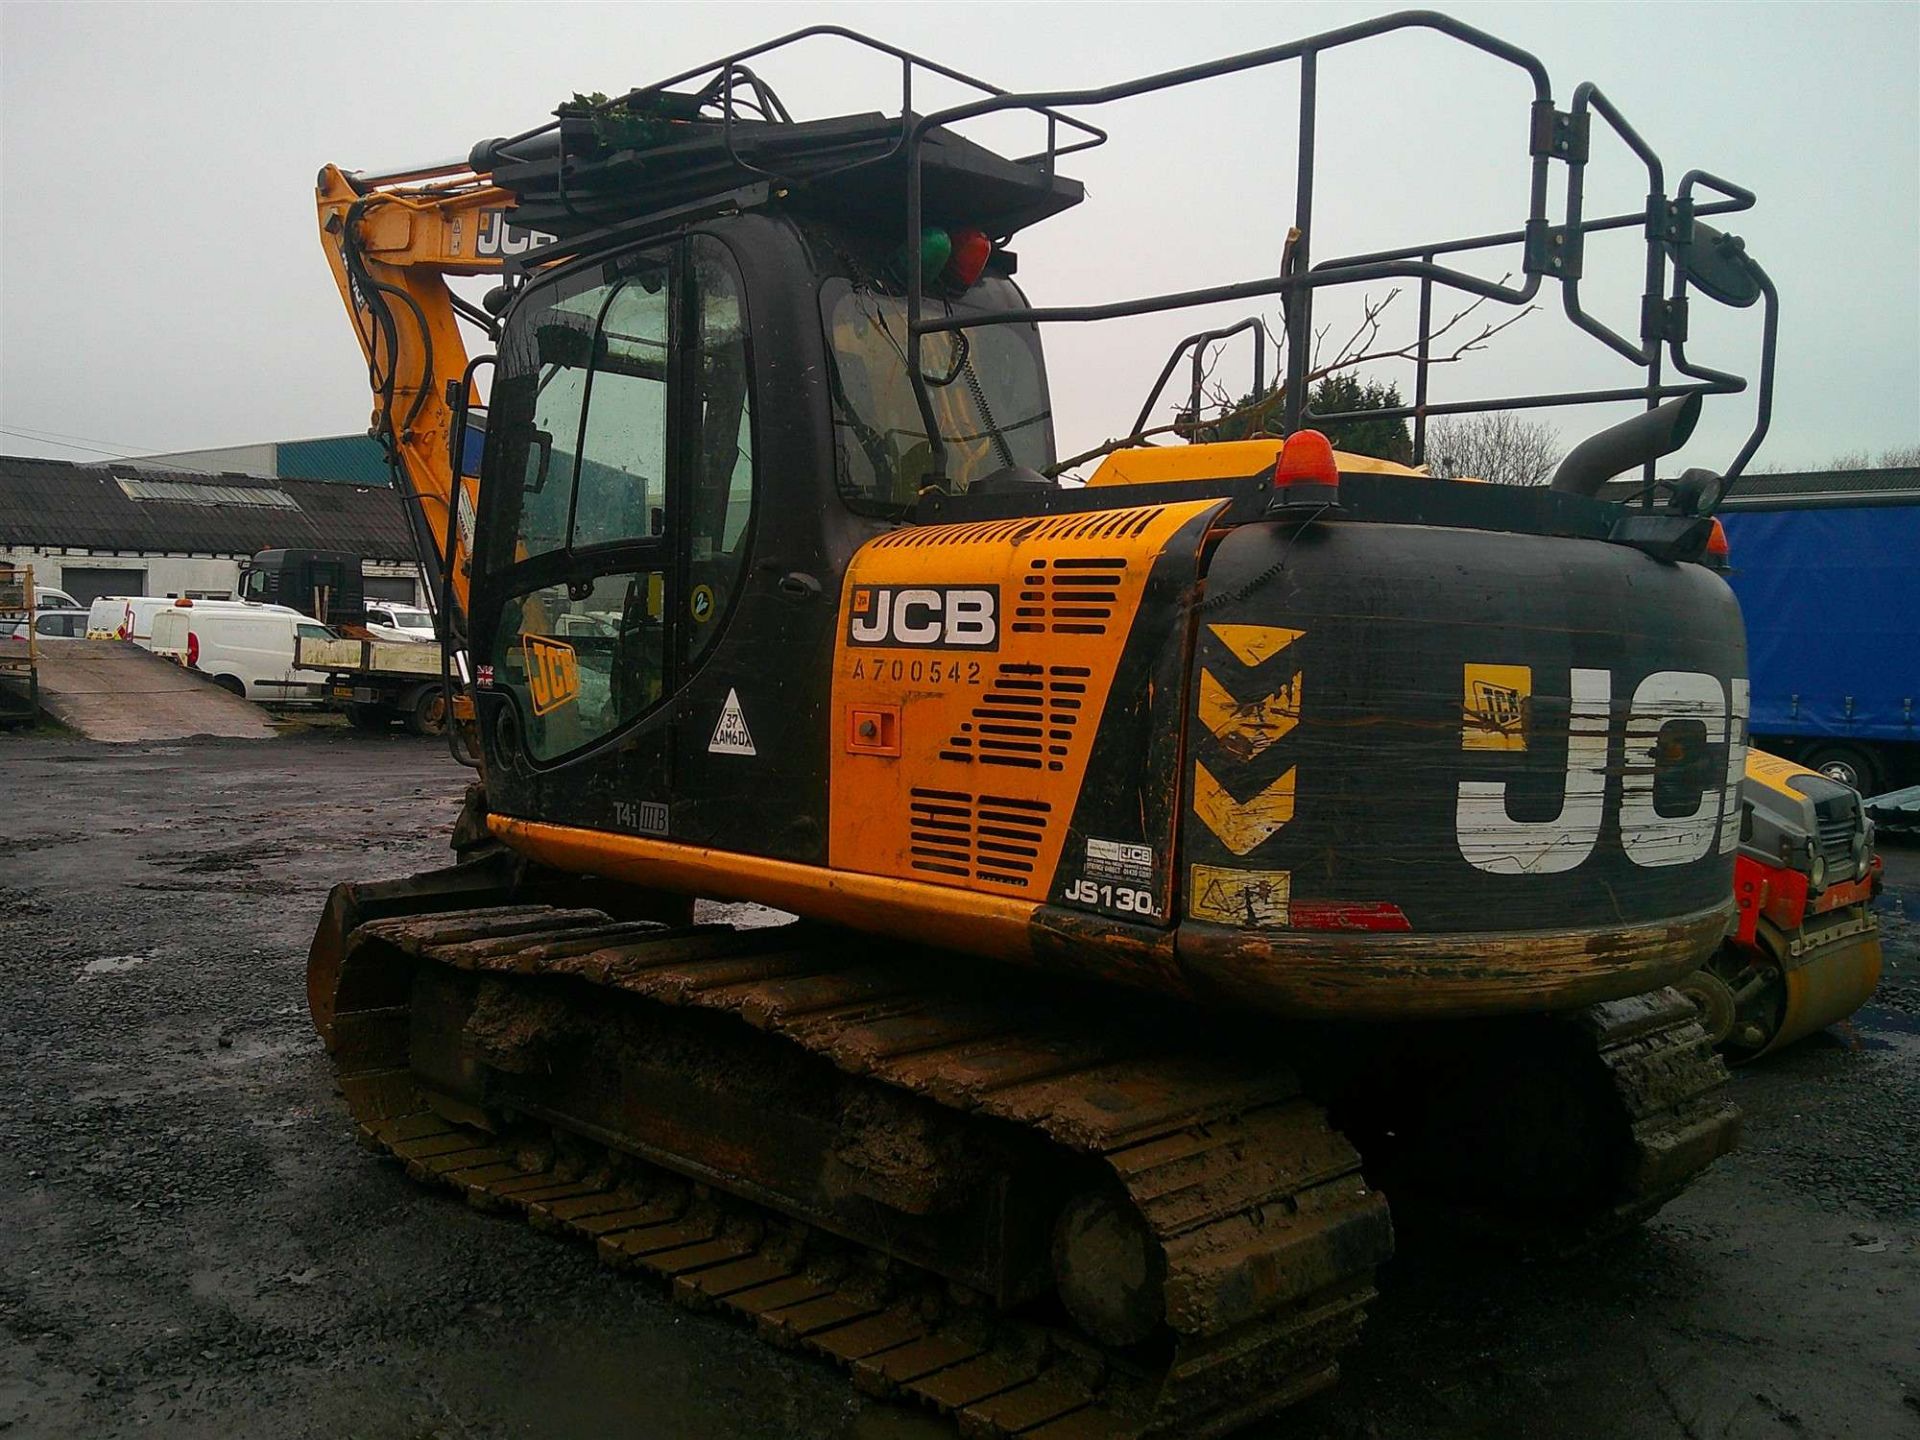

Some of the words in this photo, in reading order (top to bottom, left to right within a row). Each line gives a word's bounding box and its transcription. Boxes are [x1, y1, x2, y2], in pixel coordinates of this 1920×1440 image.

[852, 589, 996, 645] JCB
[533, 643, 577, 706] JCB
[852, 658, 980, 684] A700542
[725, 713, 738, 729] 37
[1456, 668, 1749, 874] JC
[1122, 847, 1150, 862] JCB
